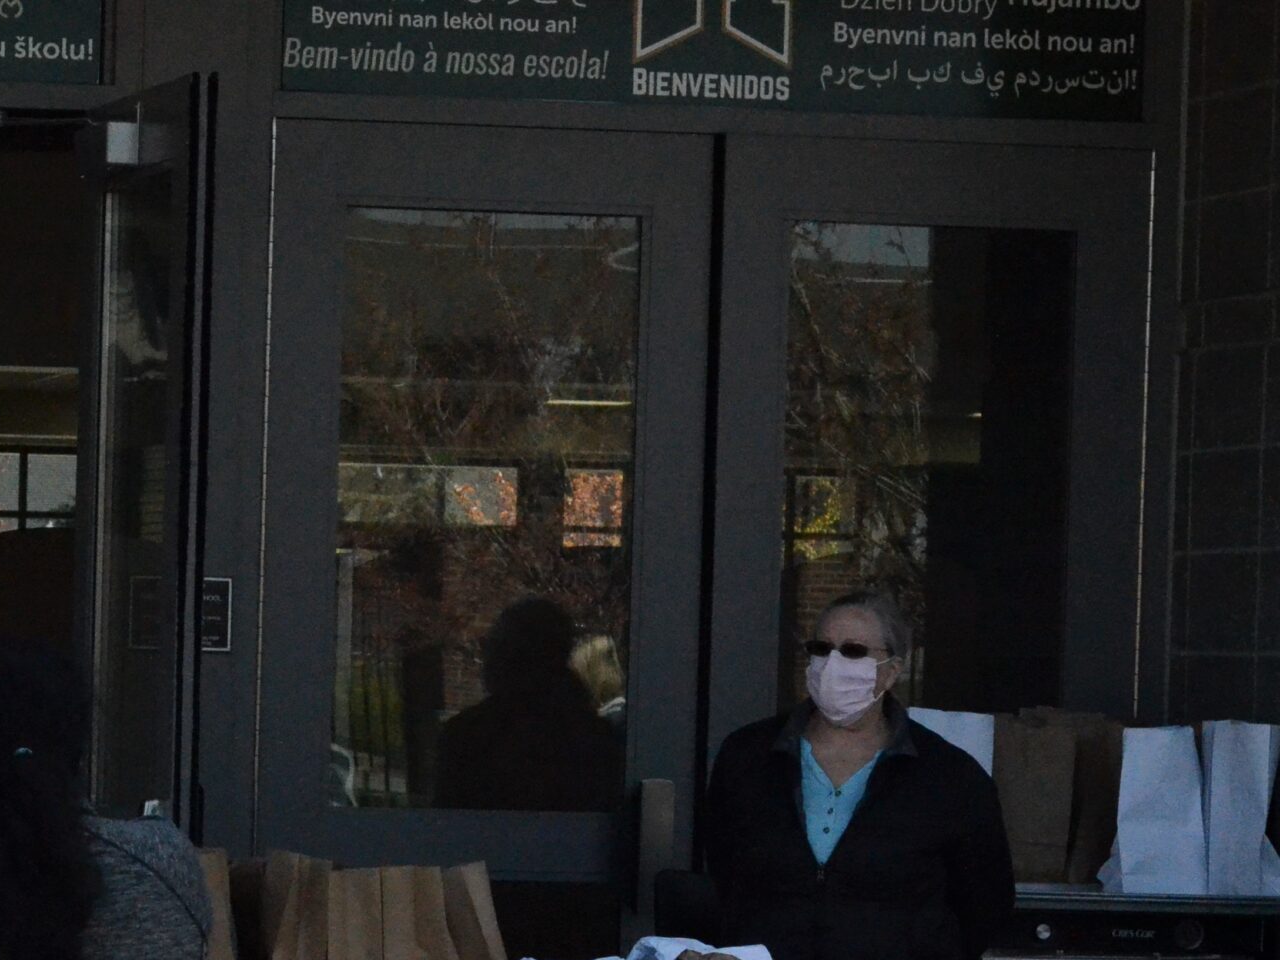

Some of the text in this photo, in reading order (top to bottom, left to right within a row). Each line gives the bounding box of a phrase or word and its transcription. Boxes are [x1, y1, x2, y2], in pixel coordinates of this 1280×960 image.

[310, 6, 578, 34] Byenvni nan lekòl nou an!
[13, 35, 95, 62] školu!
[832, 22, 1136, 54] Byenvni nan lekòl nou an!
[282, 36, 610, 80] Bem-vindo à nossa escola!
[631, 67, 791, 101] BIENVENIDOS
